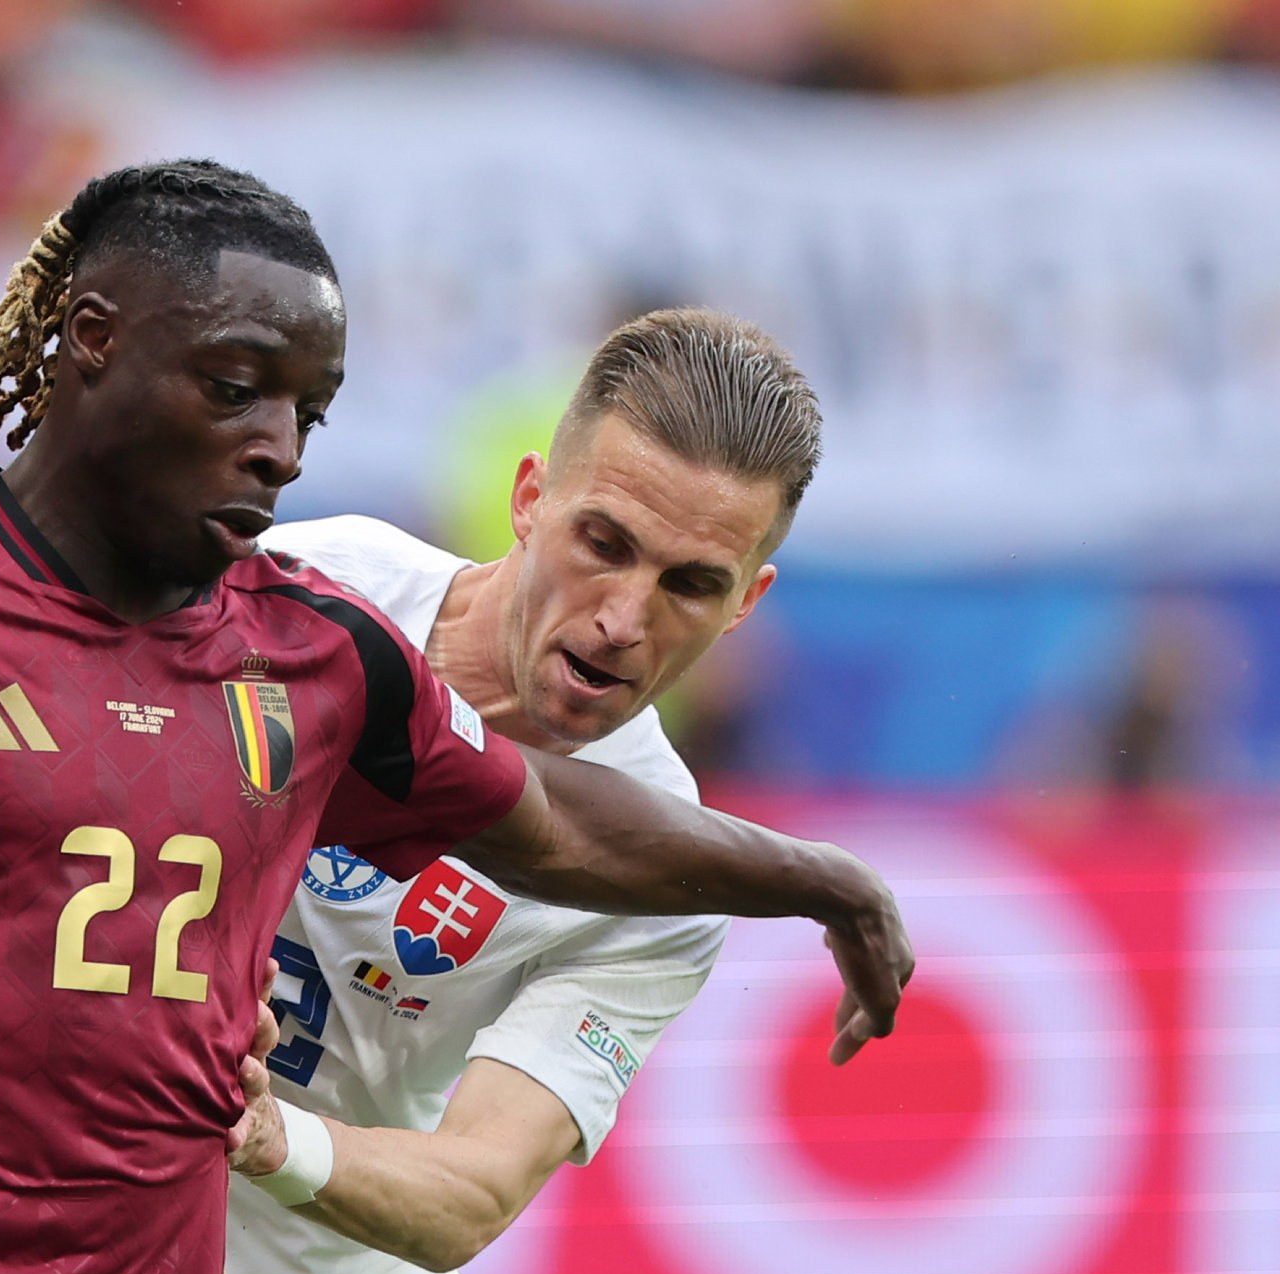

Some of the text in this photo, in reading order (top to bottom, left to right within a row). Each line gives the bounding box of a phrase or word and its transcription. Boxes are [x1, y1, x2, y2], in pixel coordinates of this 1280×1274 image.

[305, 875, 330, 897] SFZ
[53, 826, 222, 1002] 22
[349, 980, 390, 1003] FRANKFURT
[586, 1010, 610, 1034] UEFA
[577, 1019, 637, 1081] FOUNDA
